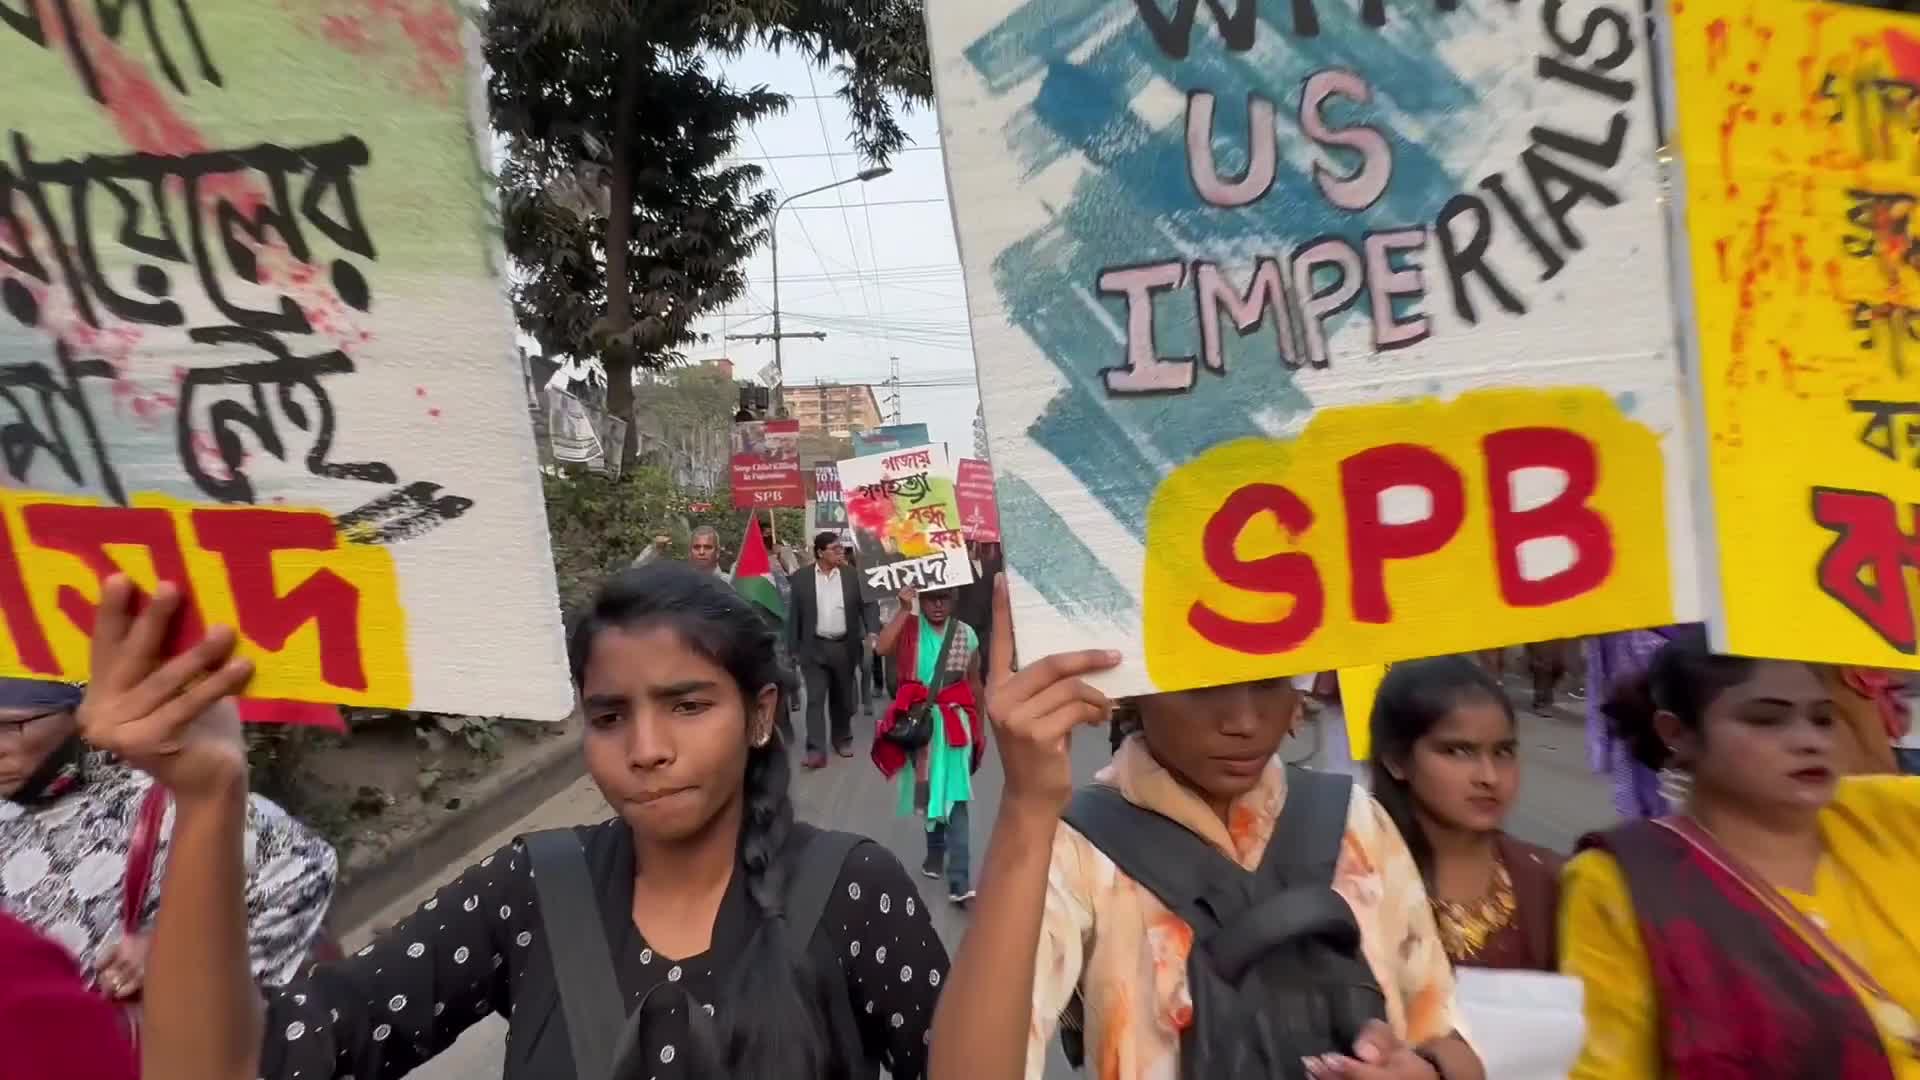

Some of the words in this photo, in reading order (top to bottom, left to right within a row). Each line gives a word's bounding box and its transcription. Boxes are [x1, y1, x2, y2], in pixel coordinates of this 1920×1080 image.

[1098, 0, 1637, 398] IMPERIALIS
[1186, 67, 1392, 212] US
[0, 128, 378, 336] রায়েলের
[754, 491, 783, 502] SPB
[864, 551, 948, 591] বাসদ
[1187, 425, 1616, 656] SPB
